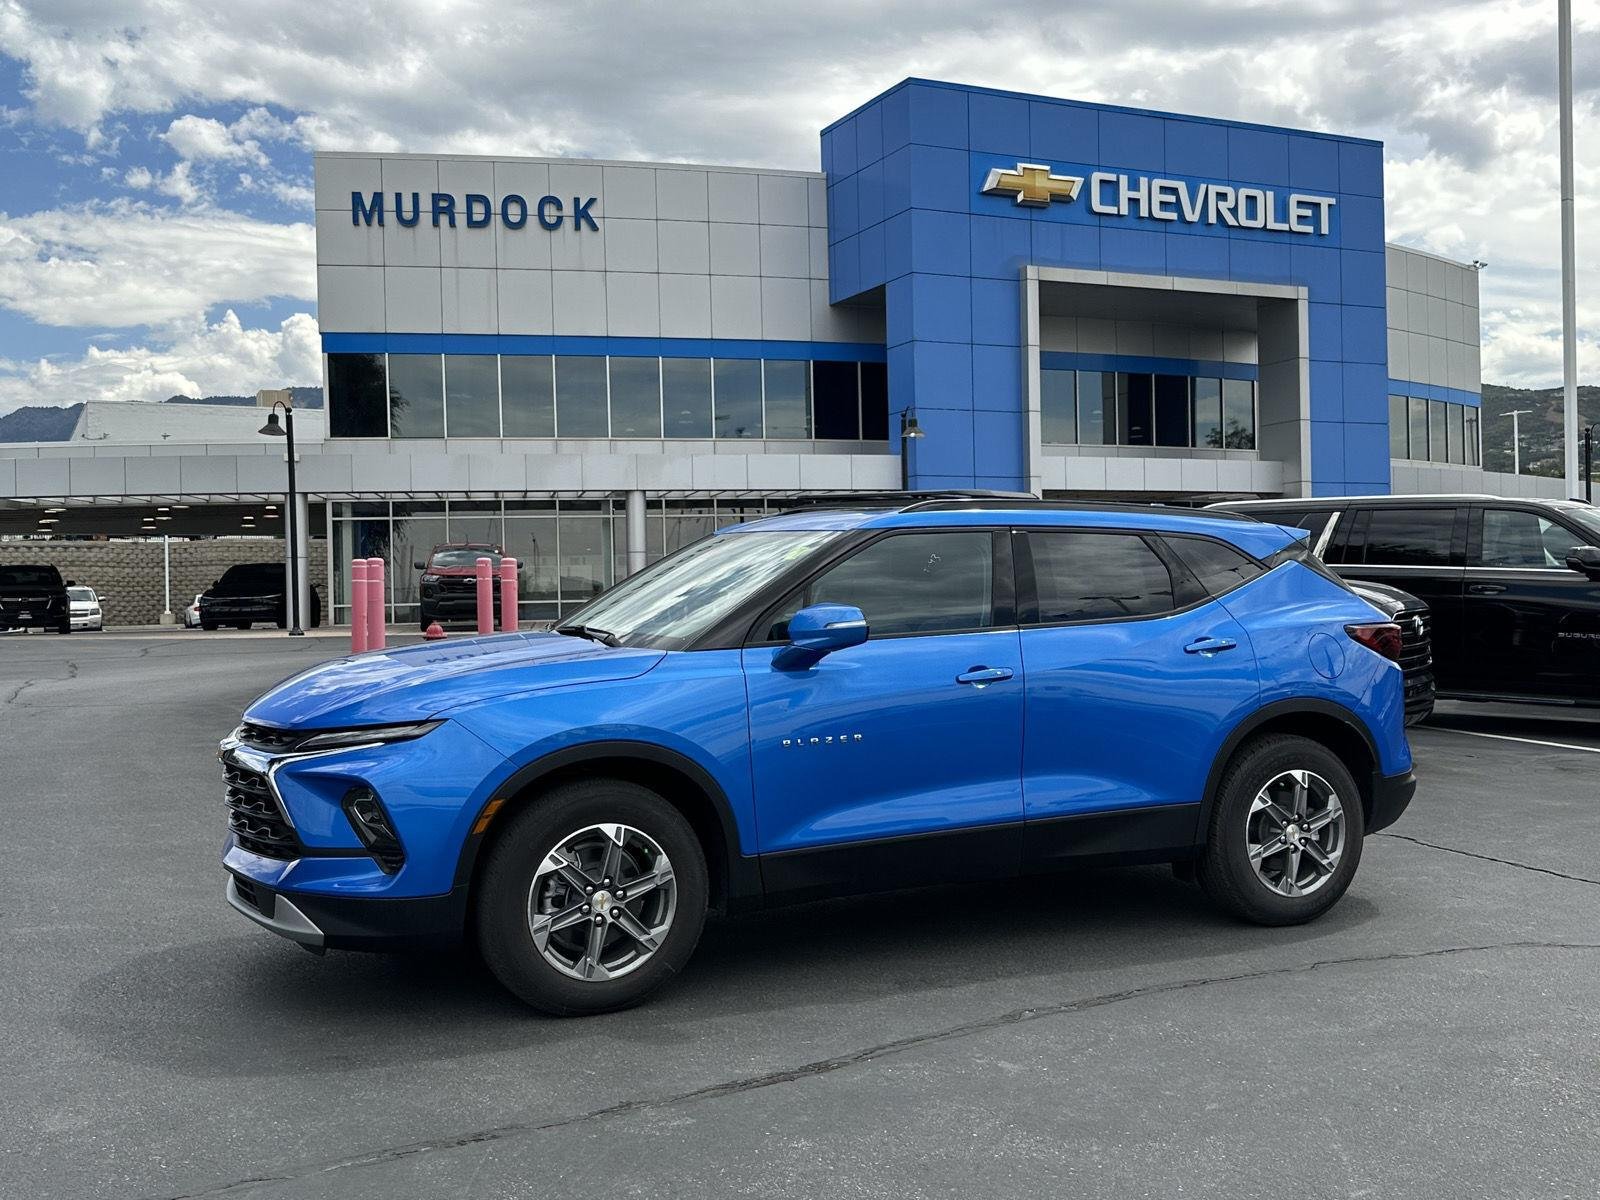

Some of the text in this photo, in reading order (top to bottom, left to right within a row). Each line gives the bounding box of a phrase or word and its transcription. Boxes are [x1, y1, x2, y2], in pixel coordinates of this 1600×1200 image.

[351, 191, 599, 231] MURDOCK
[1090, 171, 1336, 235] CHEVROLET
[782, 733, 863, 747] BLAZER
